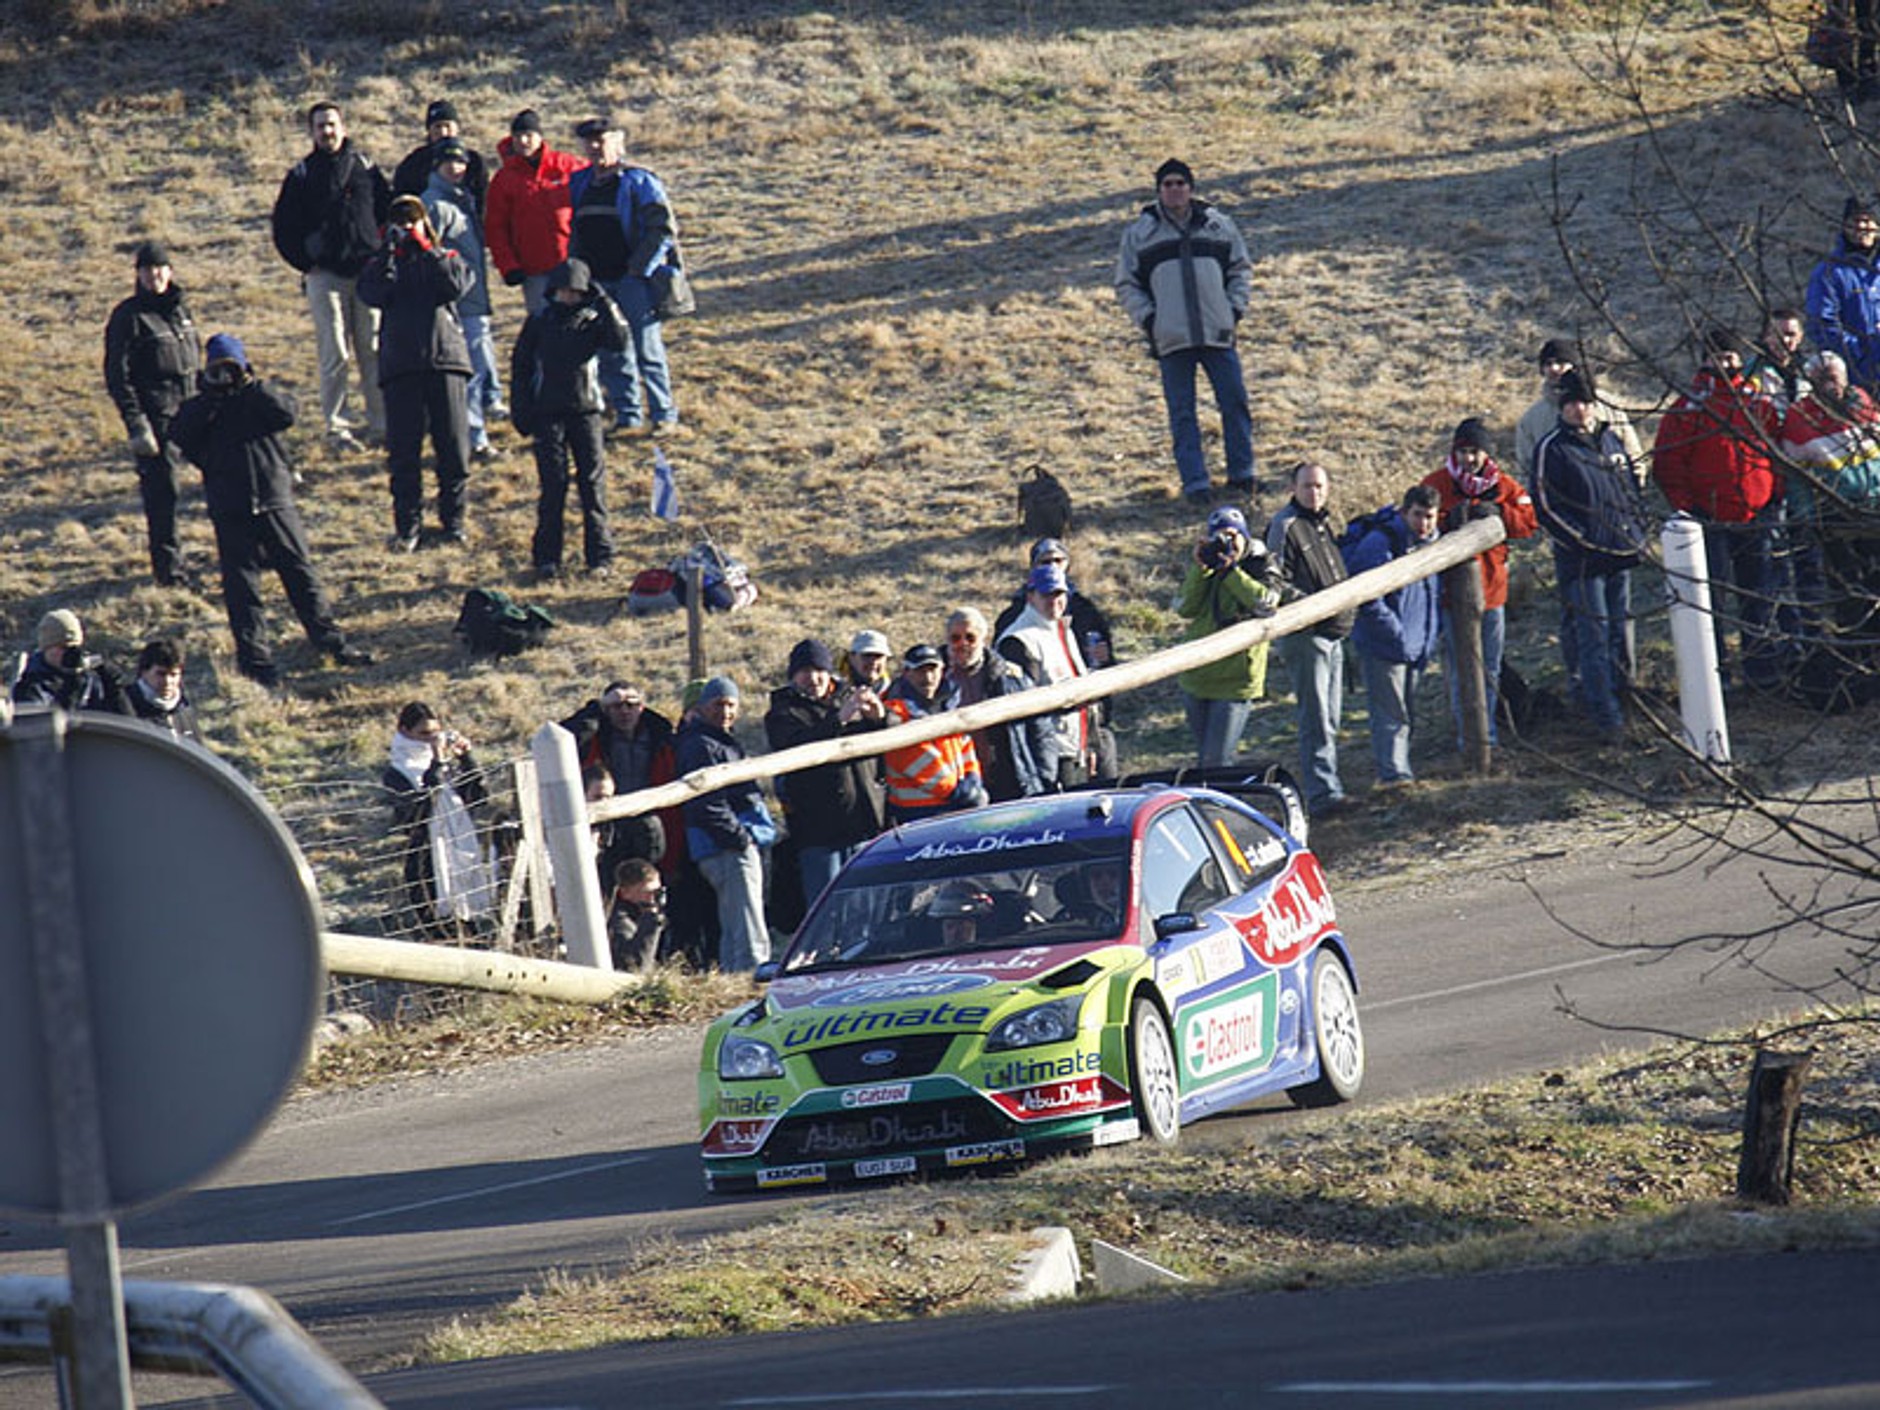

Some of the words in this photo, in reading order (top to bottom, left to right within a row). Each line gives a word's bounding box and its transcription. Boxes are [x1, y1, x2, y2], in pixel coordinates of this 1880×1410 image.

[784, 1002, 991, 1047] ultimate
[1207, 1002, 1257, 1065] Castrol
[985, 1048, 1101, 1088] ultimate
[858, 1086, 906, 1103] Castrol
[797, 1122, 868, 1154] Abu
[869, 1109, 969, 1147] Dhabi
